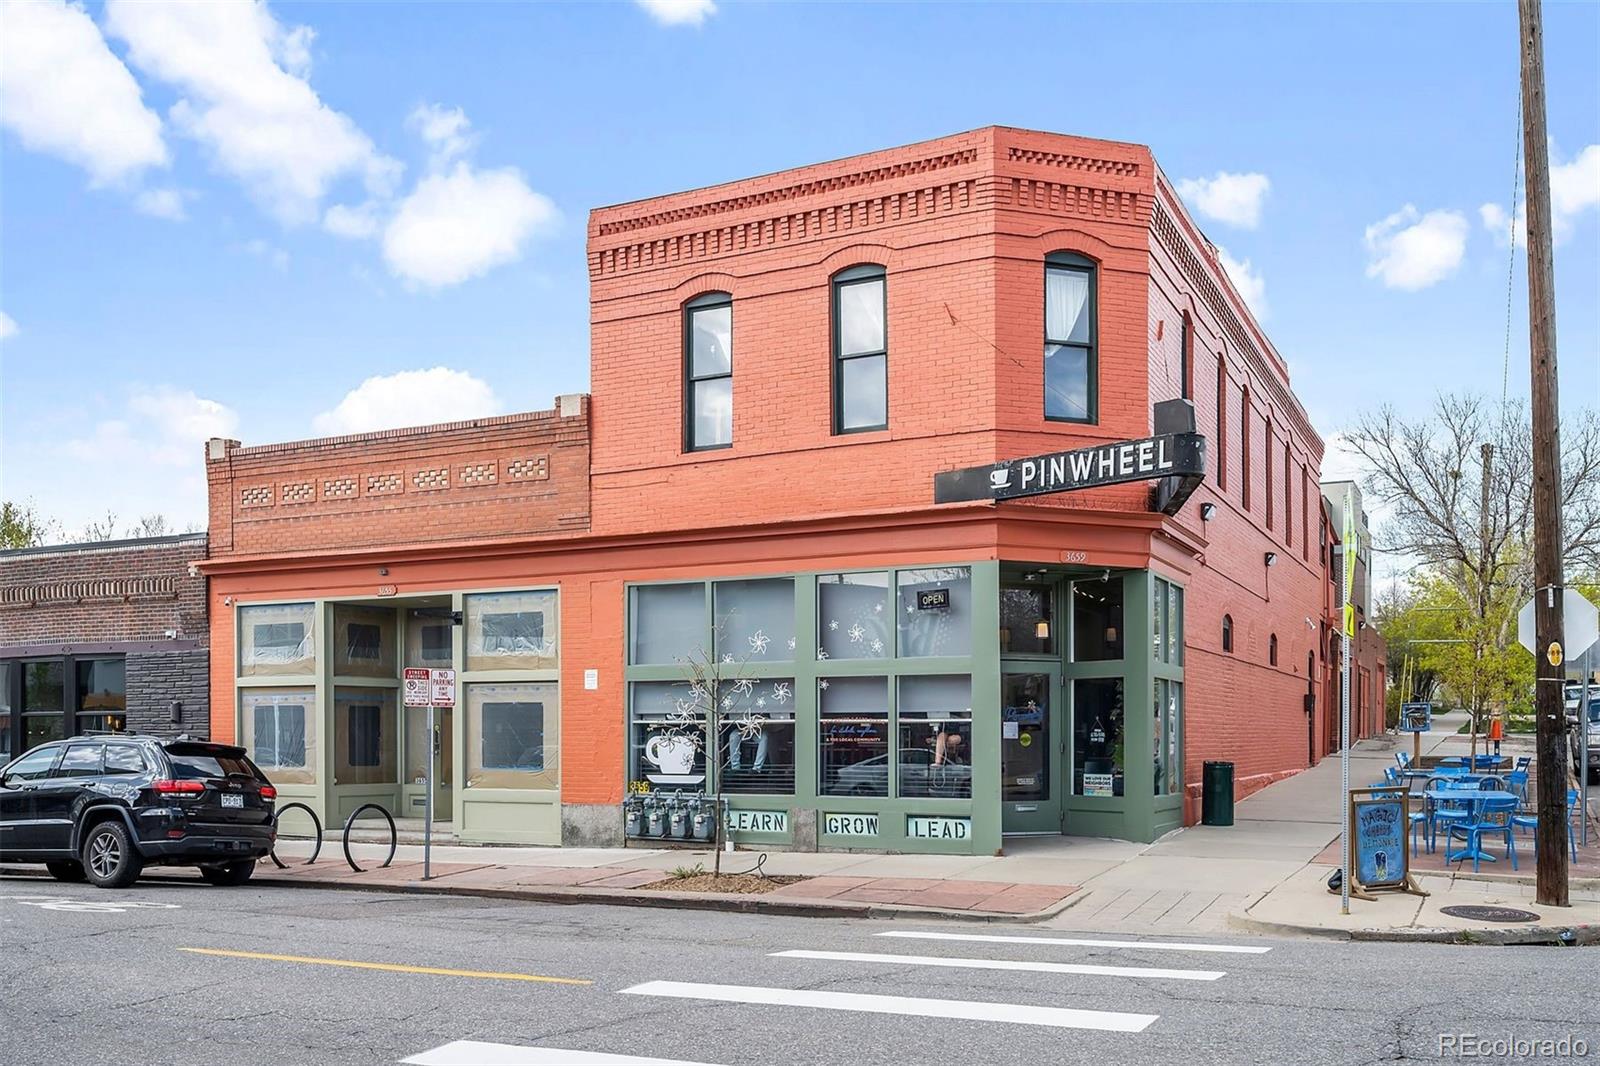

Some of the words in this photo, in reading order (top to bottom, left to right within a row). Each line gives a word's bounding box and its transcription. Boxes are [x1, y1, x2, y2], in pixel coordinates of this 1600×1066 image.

[1021, 440, 1173, 489] PINWHEEL
[1066, 551, 1086, 562] 3659
[922, 594, 944, 605] OPEN
[438, 671, 448, 679] NO
[432, 679, 454, 687] PARKING
[828, 817, 878, 835] GROW
[914, 815, 966, 838] LEAD
